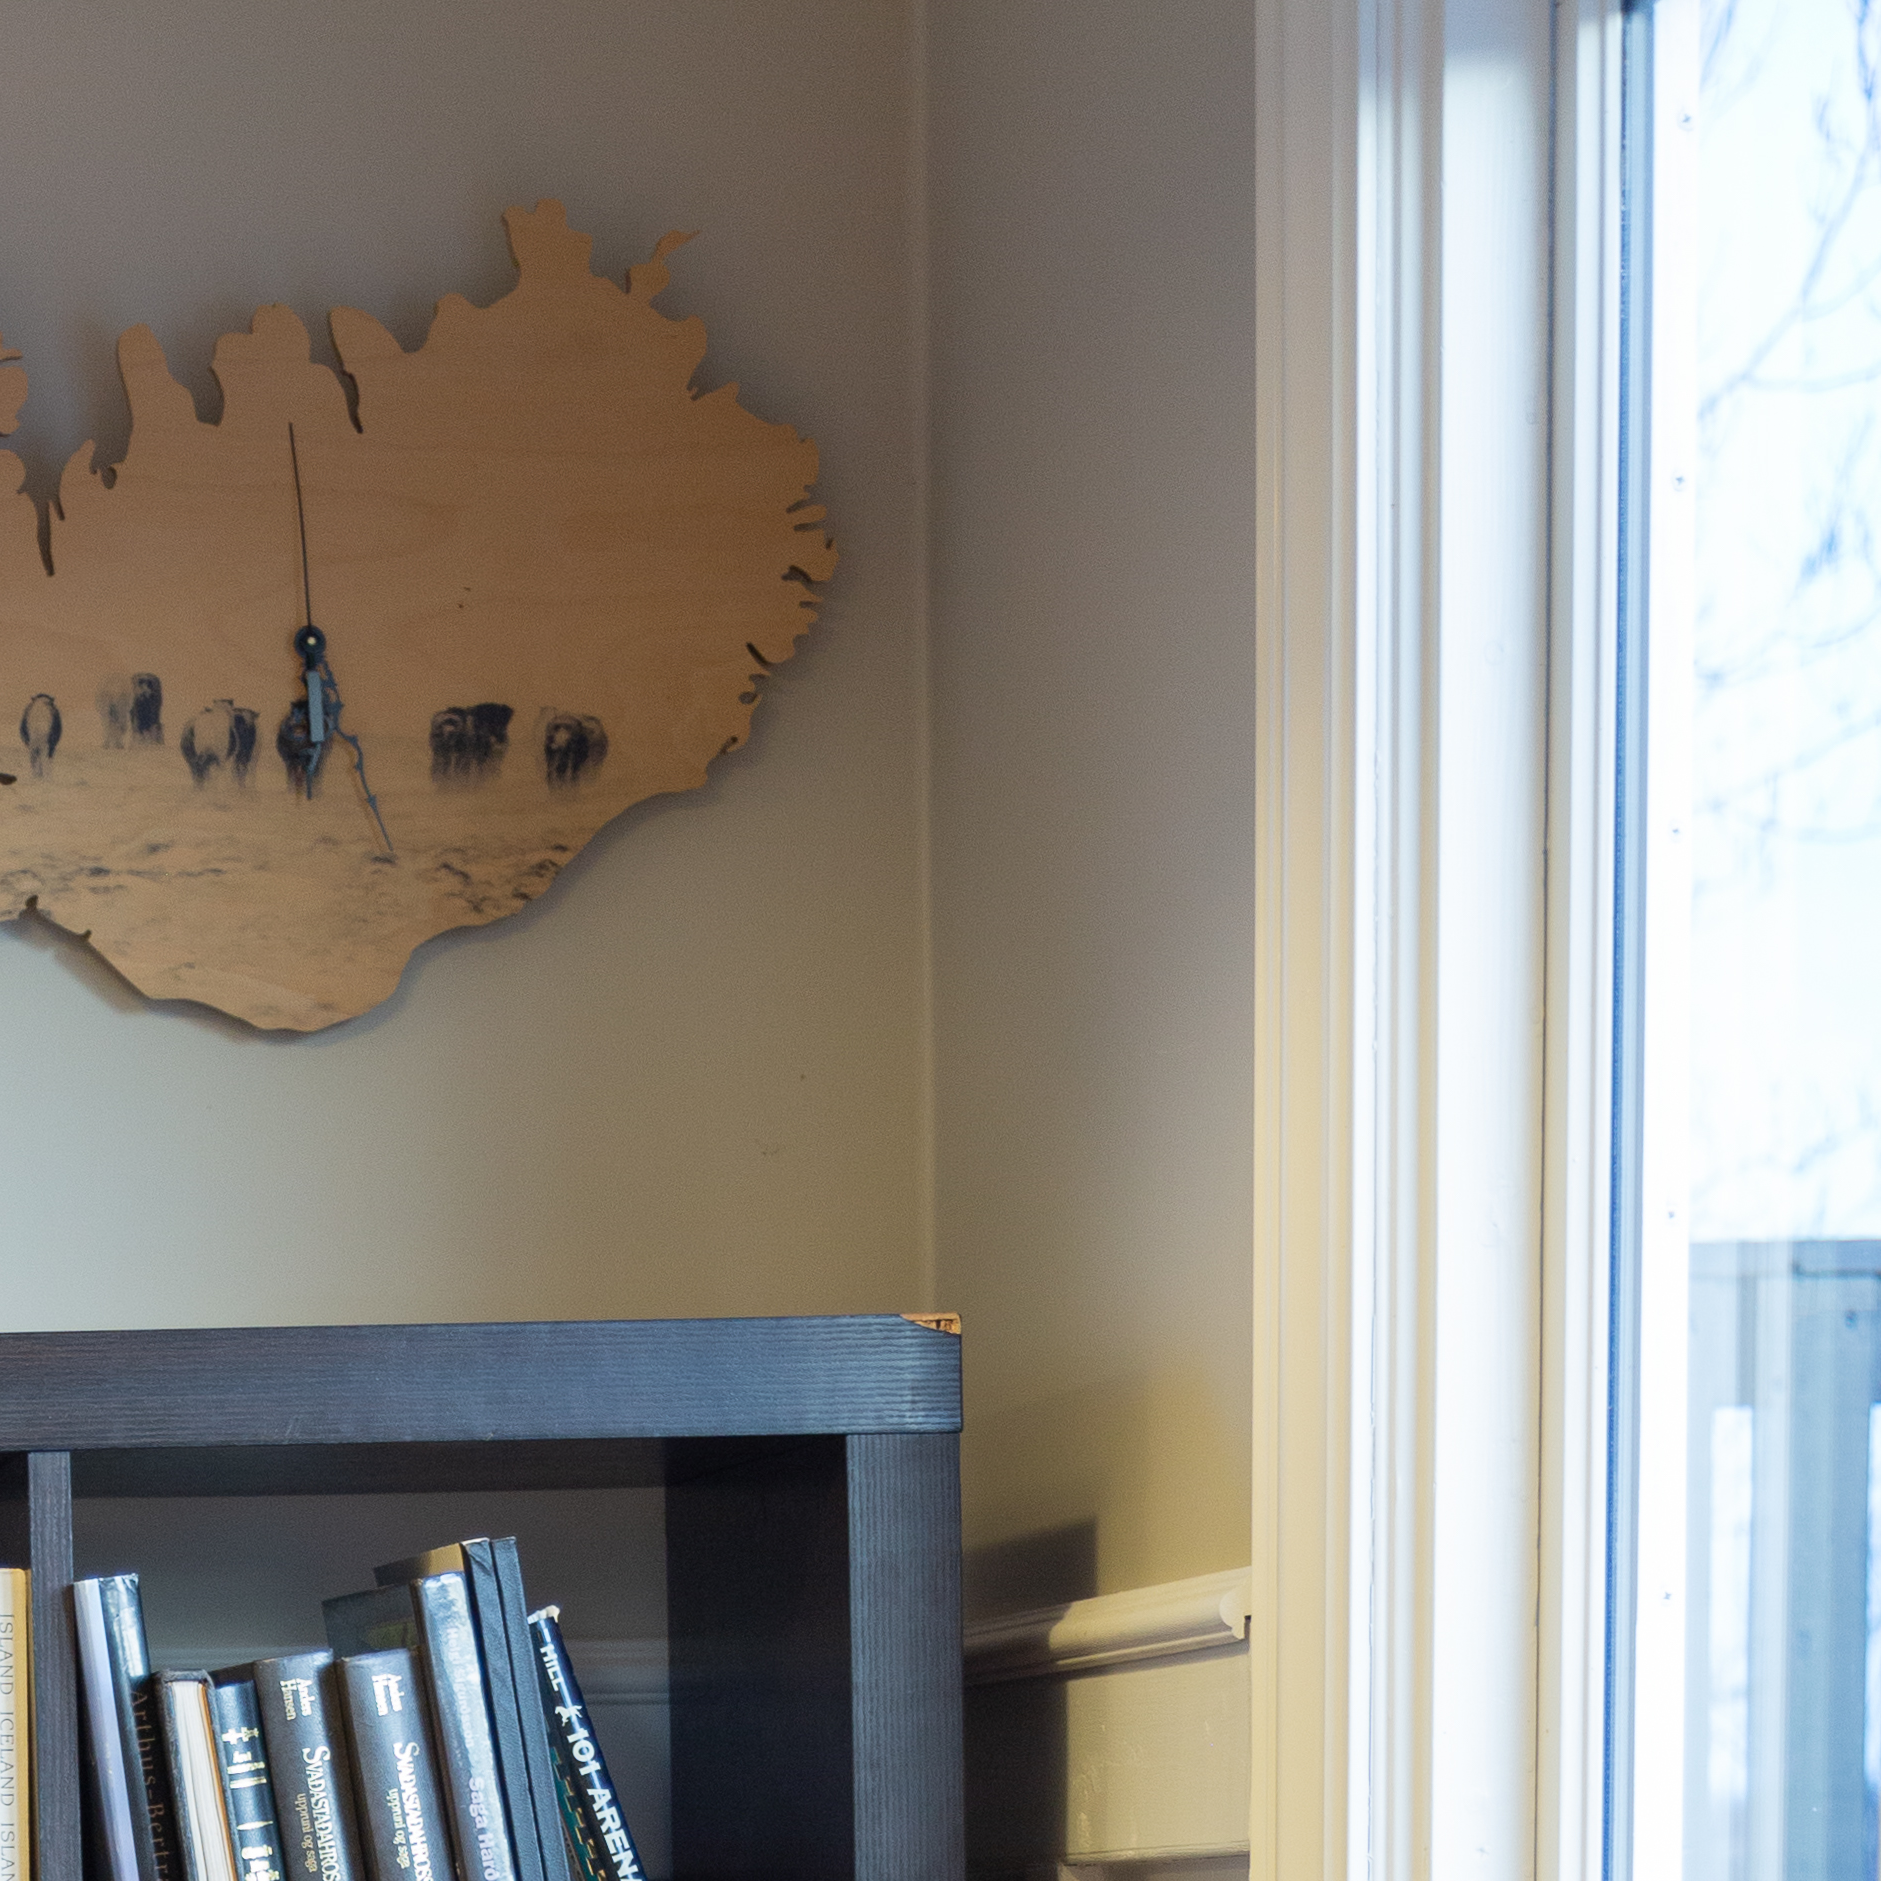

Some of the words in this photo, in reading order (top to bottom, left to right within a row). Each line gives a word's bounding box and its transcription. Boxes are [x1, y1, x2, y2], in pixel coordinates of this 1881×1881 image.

[0, 1614, 15, 1695] ÍSLAND
[387, 1674, 404, 1711] Anders
[296, 1679, 314, 1716] Anders
[540, 1644, 563, 1692] HILL
[567, 1728, 601, 1776] 101
[0, 1711, 15, 1806] ICELAND
